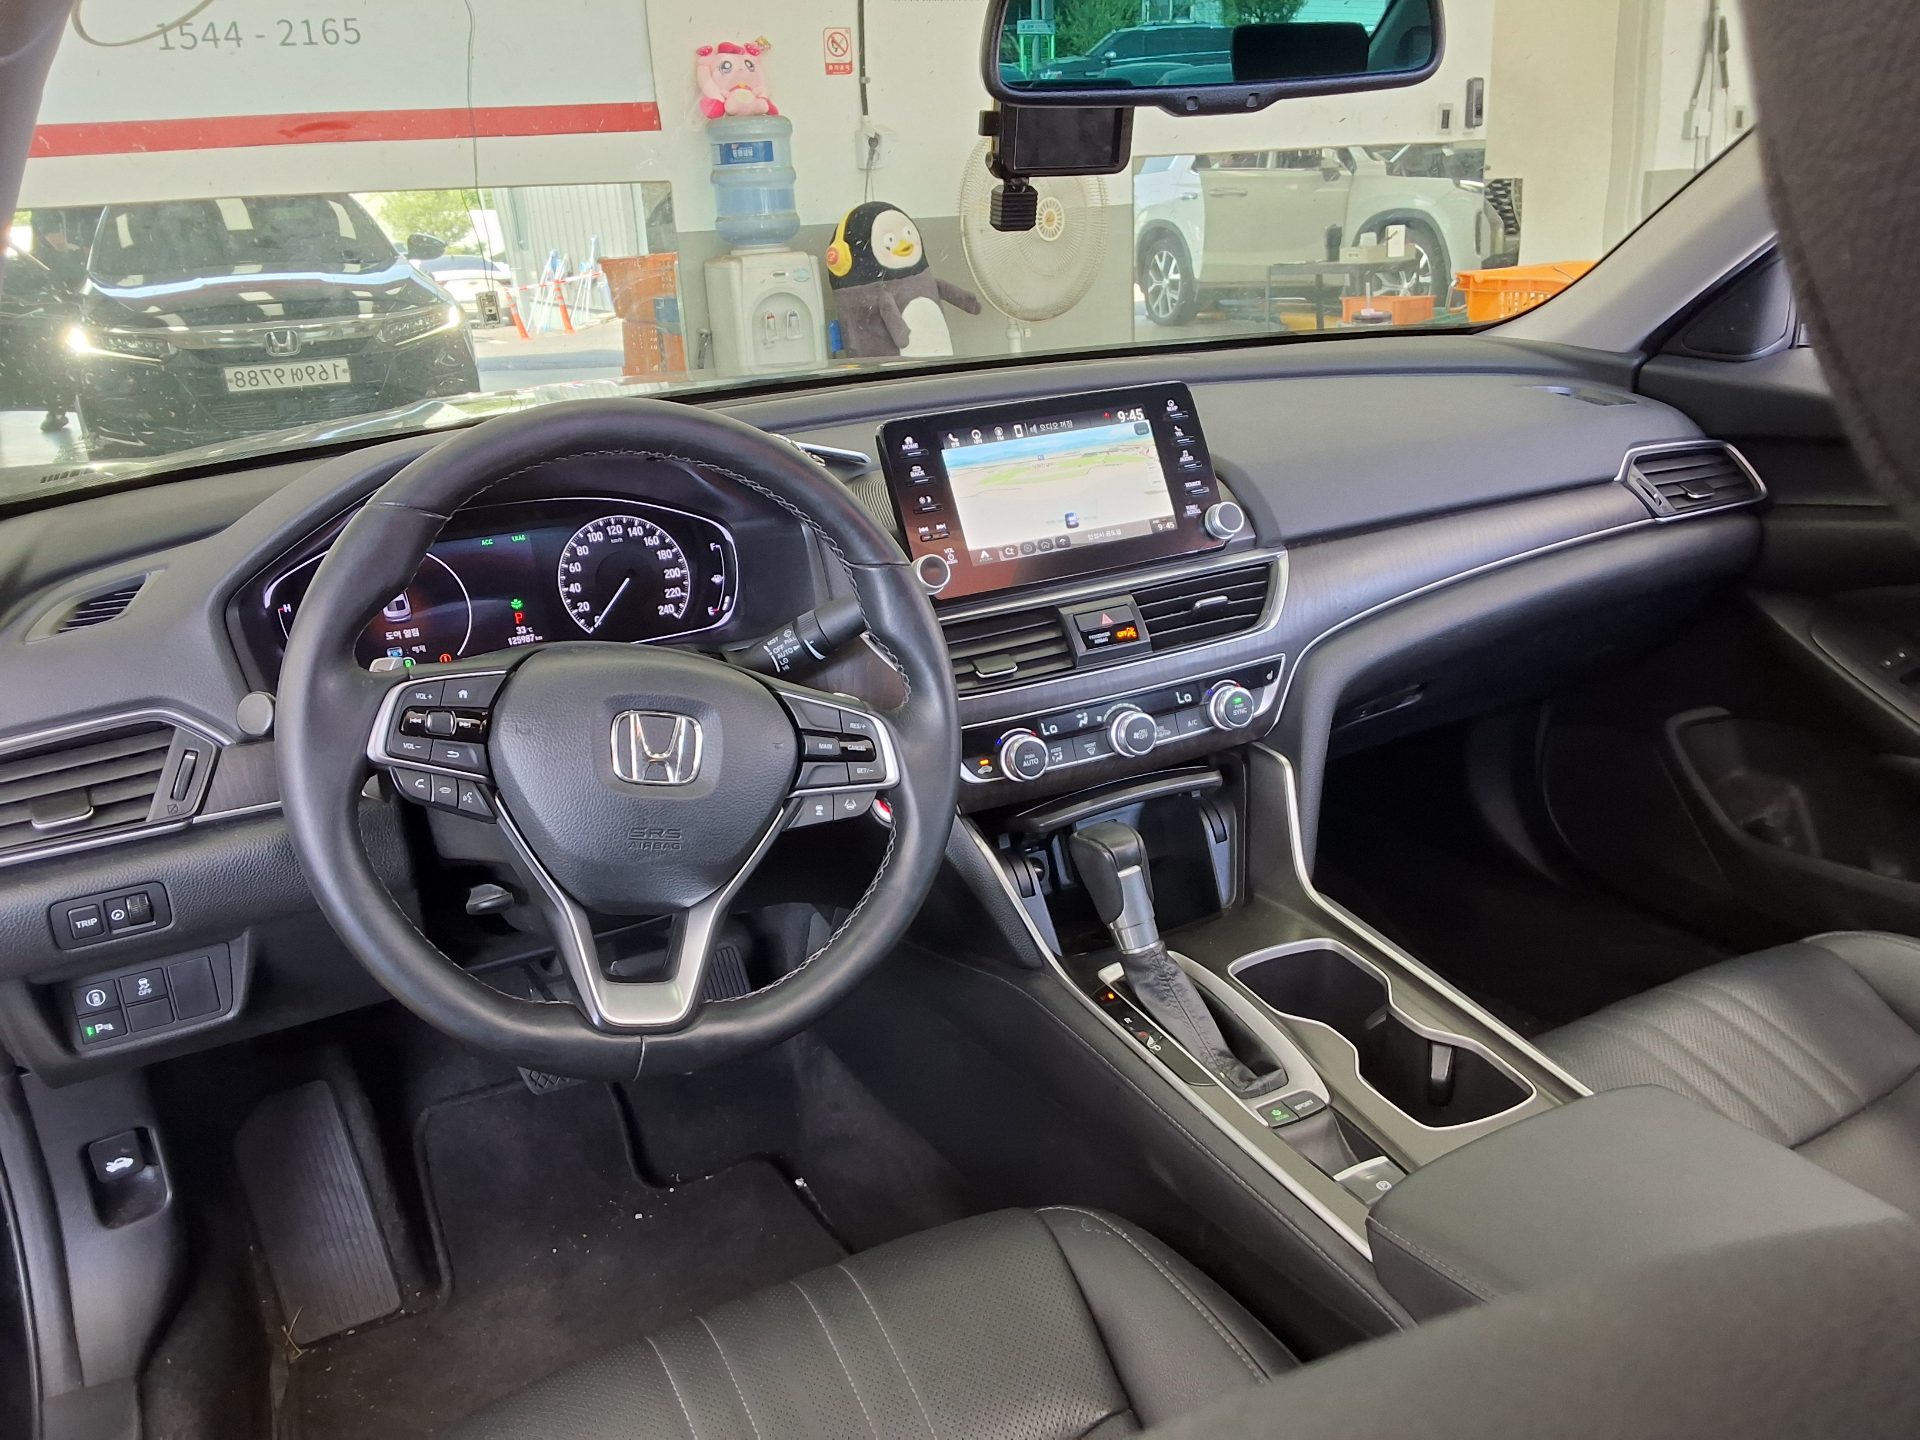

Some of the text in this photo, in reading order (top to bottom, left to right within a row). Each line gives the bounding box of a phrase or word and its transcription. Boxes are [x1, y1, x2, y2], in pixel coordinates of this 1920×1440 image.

[156, 21, 243, 50] 1544
[276, 17, 361, 47] 2165
[1117, 408, 1144, 422] 9:45
[1040, 423, 1058, 431] 오디오
[607, 526, 623, 536] 120
[628, 526, 643, 536] 140
[1157, 522, 1175, 531] 9:45
[588, 531, 604, 542] 100
[644, 535, 659, 546] 160
[577, 545, 589, 556] 80
[657, 549, 672, 560] 180
[569, 562, 581, 573] 60
[664, 568, 680, 578] 200
[569, 582, 581, 593] 40
[665, 587, 681, 598] 220
[283, 604, 291, 612] H
[577, 601, 590, 612] 20
[658, 604, 674, 615] 240
[515, 612, 523, 624] P
[385, 628, 420, 640] 도어 열림
[516, 626, 526, 634] 33
[508, 633, 534, 645] 125987
[773, 644, 785, 654] OFF
[777, 647, 794, 659] AUTO
[780, 657, 789, 665] LO
[1233, 707, 1248, 716] SYNC
[1188, 719, 1198, 727] A/C
[1023, 759, 1039, 768] AUTO
[629, 828, 682, 840] SRS
[628, 841, 682, 850] AIRBAG
[75, 918, 98, 929] TRIP
[138, 987, 152, 996] OFF
